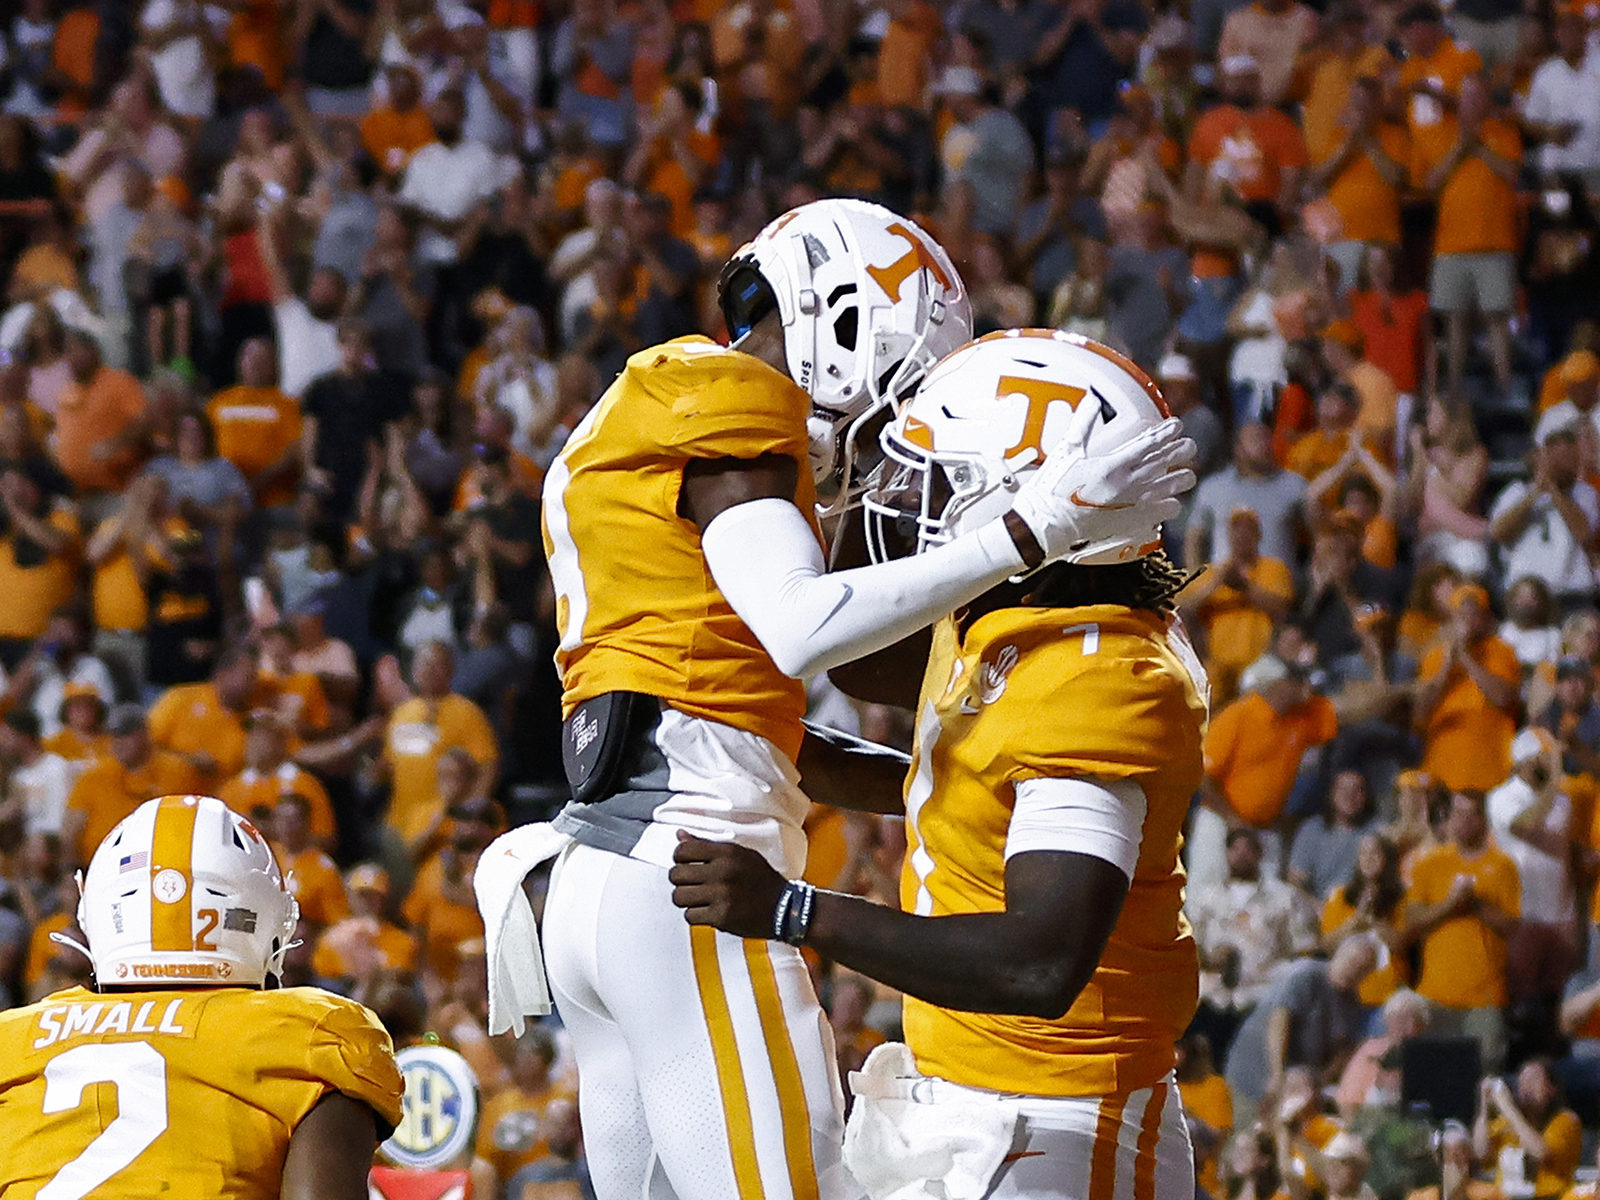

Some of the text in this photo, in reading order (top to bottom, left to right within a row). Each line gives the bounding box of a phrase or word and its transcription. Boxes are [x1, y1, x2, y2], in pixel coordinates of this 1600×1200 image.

[865, 222, 952, 305] T
[996, 375, 1087, 466] T
[1062, 622, 1100, 656] 7
[195, 908, 219, 951] 2
[33, 998, 184, 1049] SMALL
